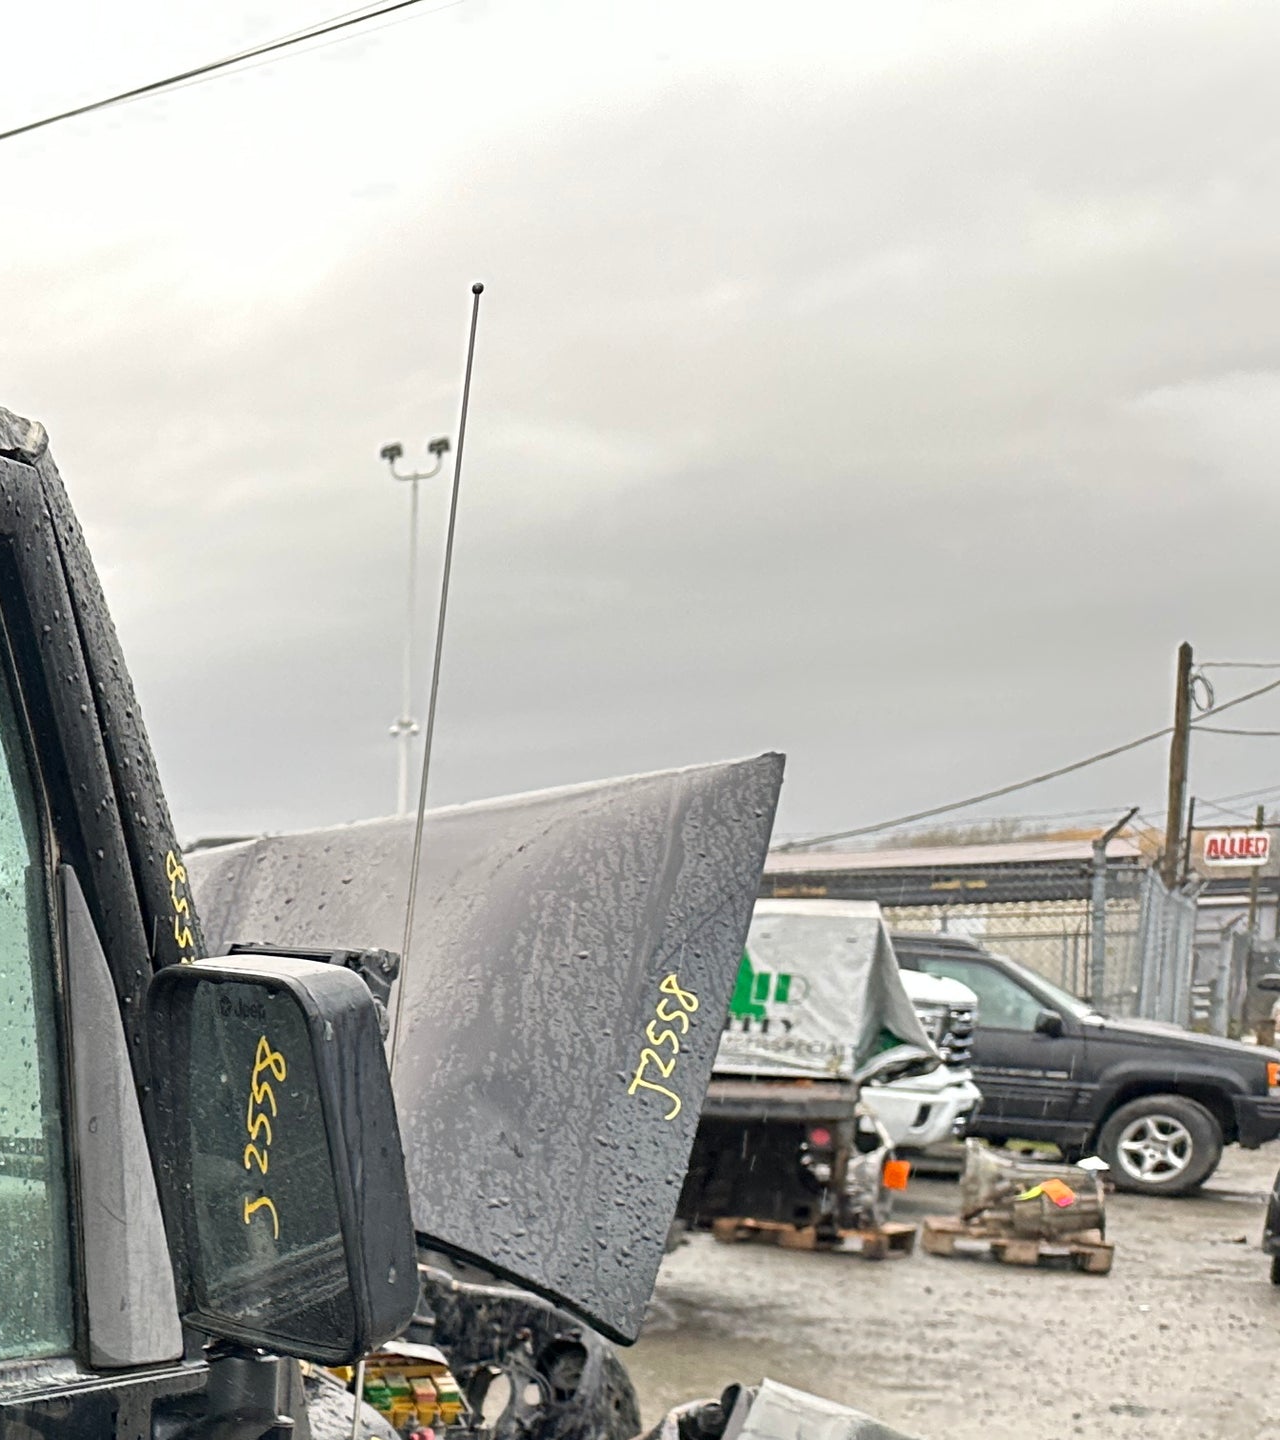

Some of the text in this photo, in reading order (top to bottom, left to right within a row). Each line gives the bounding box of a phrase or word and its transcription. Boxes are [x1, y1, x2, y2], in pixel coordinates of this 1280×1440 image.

[165, 849, 195, 965] 558
[1206, 837, 1268, 859] ALLIED
[627, 973, 699, 1120] J2558
[243, 1034, 288, 1240] J2558
